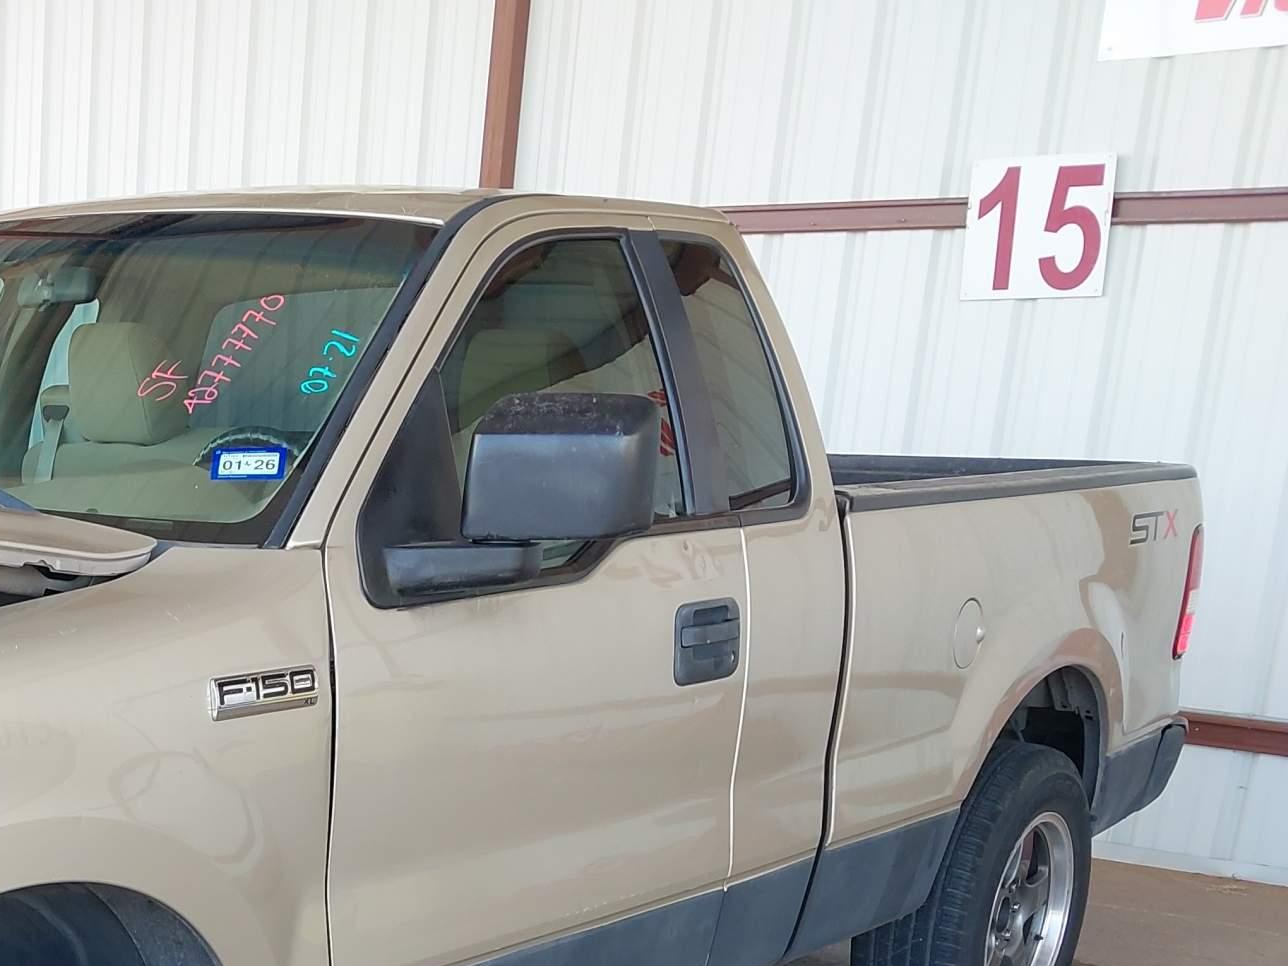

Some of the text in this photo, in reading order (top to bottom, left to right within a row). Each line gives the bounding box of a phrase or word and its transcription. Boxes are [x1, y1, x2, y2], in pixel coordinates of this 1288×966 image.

[977, 163, 1106, 291] 15
[137, 359, 189, 401] SF
[1129, 509, 1179, 545] STX
